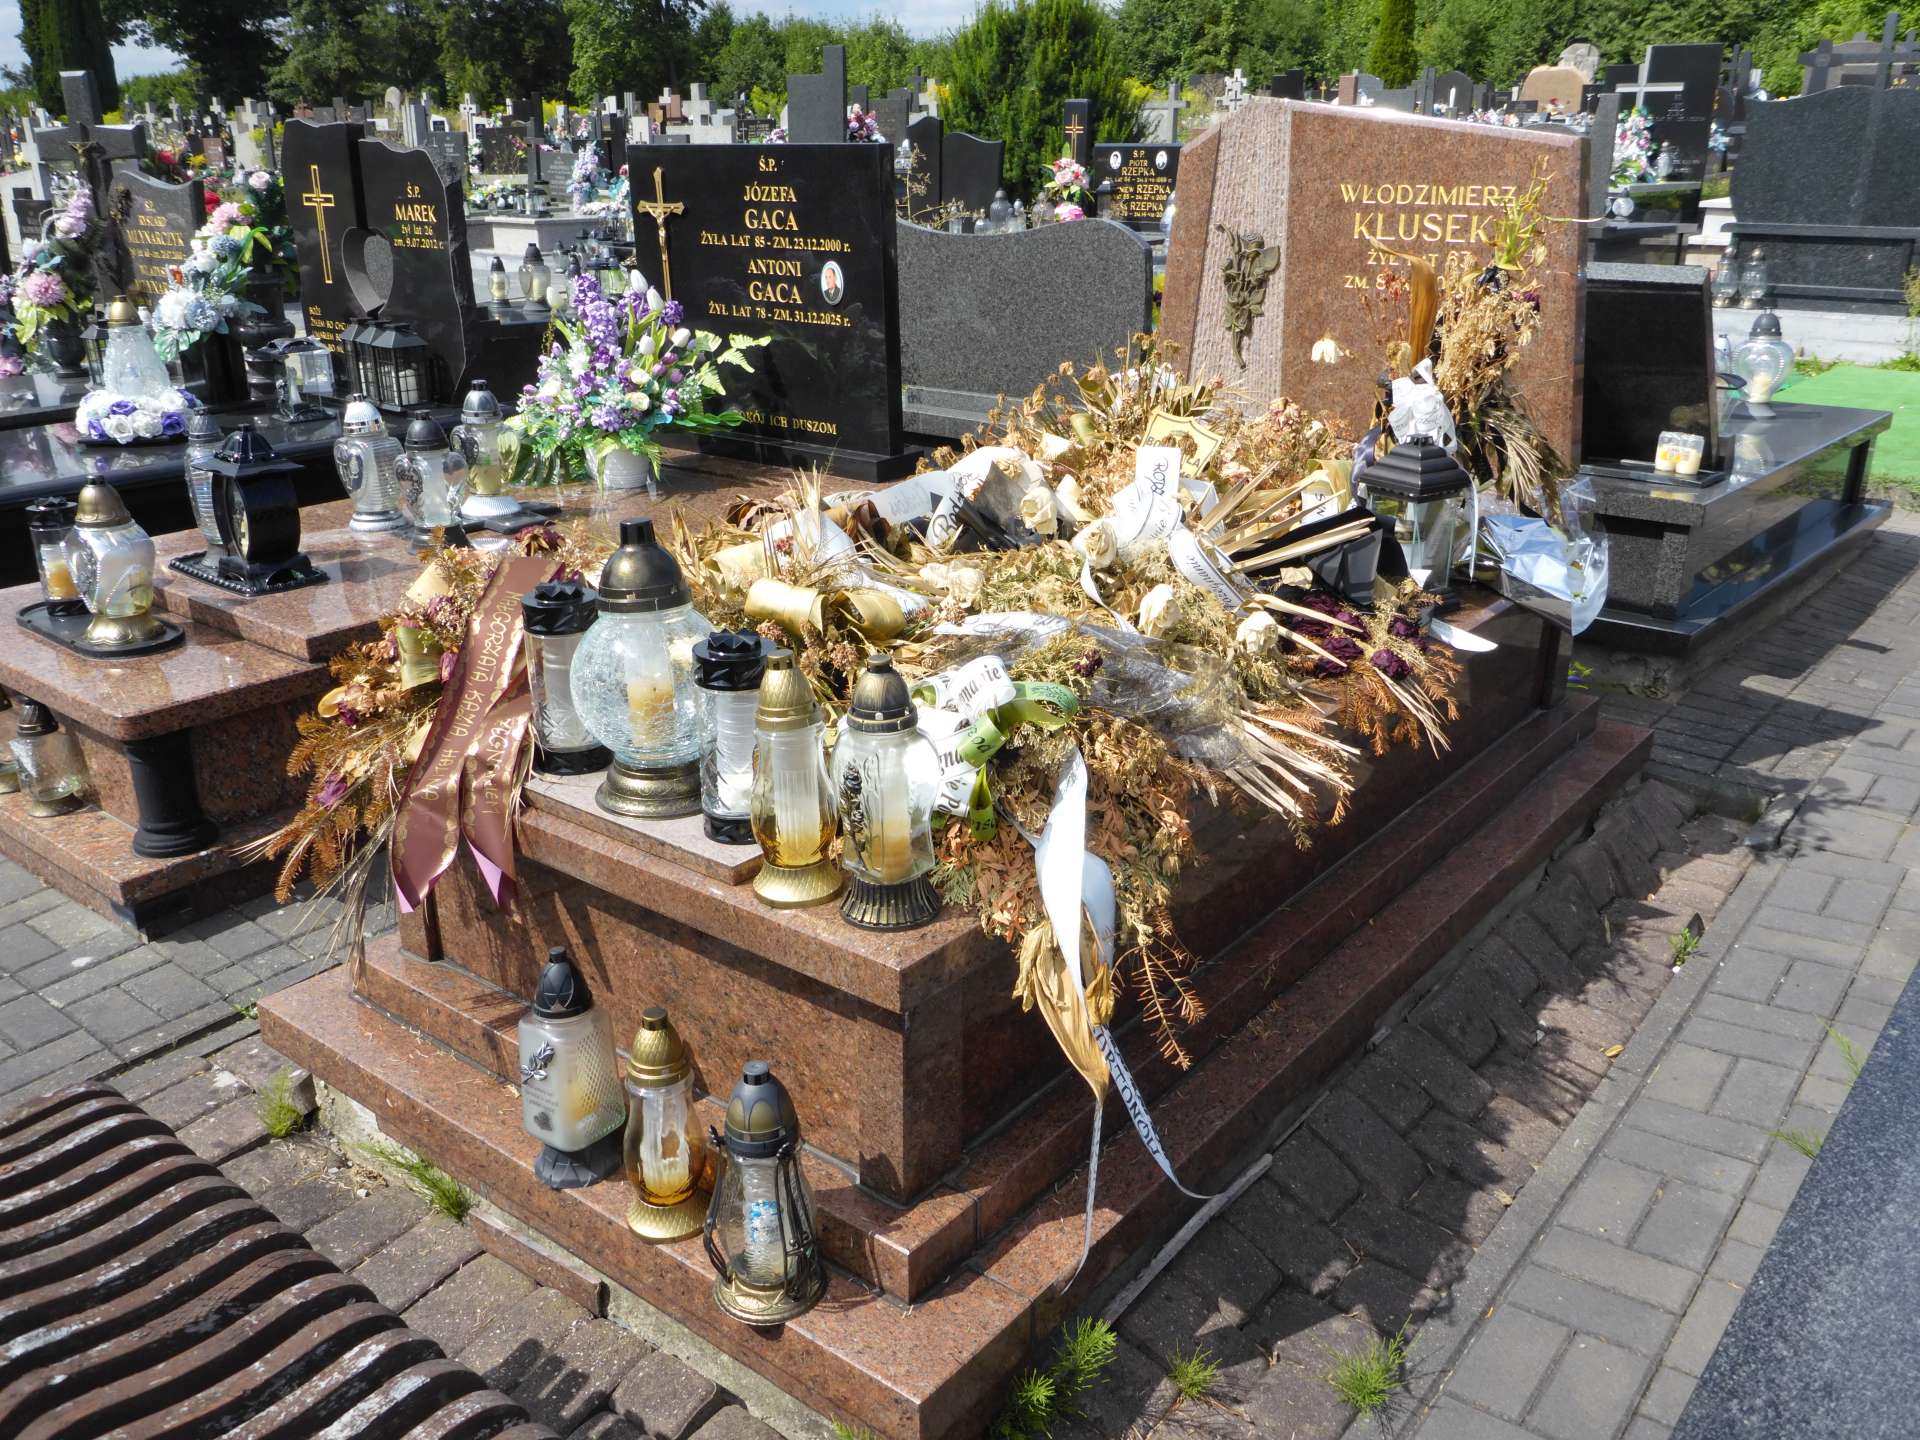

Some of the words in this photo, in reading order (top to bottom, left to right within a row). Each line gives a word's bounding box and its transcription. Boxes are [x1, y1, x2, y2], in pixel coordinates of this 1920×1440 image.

[1121, 167, 1155, 176] RZEPKA
[743, 181, 798, 202] JÓZEFA
[1136, 184, 1171, 194] RZEPKA
[1340, 183, 1517, 207] WŁODZIMIERZ
[395, 203, 437, 222] MAREK
[1130, 201, 1163, 211] RZEPKA
[744, 208, 800, 231] GACA
[1354, 212, 1497, 243] KLUSEK
[731, 234, 751, 247] LAT
[754, 235, 765, 248] 85
[748, 259, 802, 277] ANTONI
[749, 281, 803, 304] GACA
[708, 300, 729, 316] ŻYŁ
[732, 305, 752, 318] LAT
[756, 307, 766, 320] 78
[770, 415, 788, 428] ICH
[792, 417, 837, 435] DUSZOM
